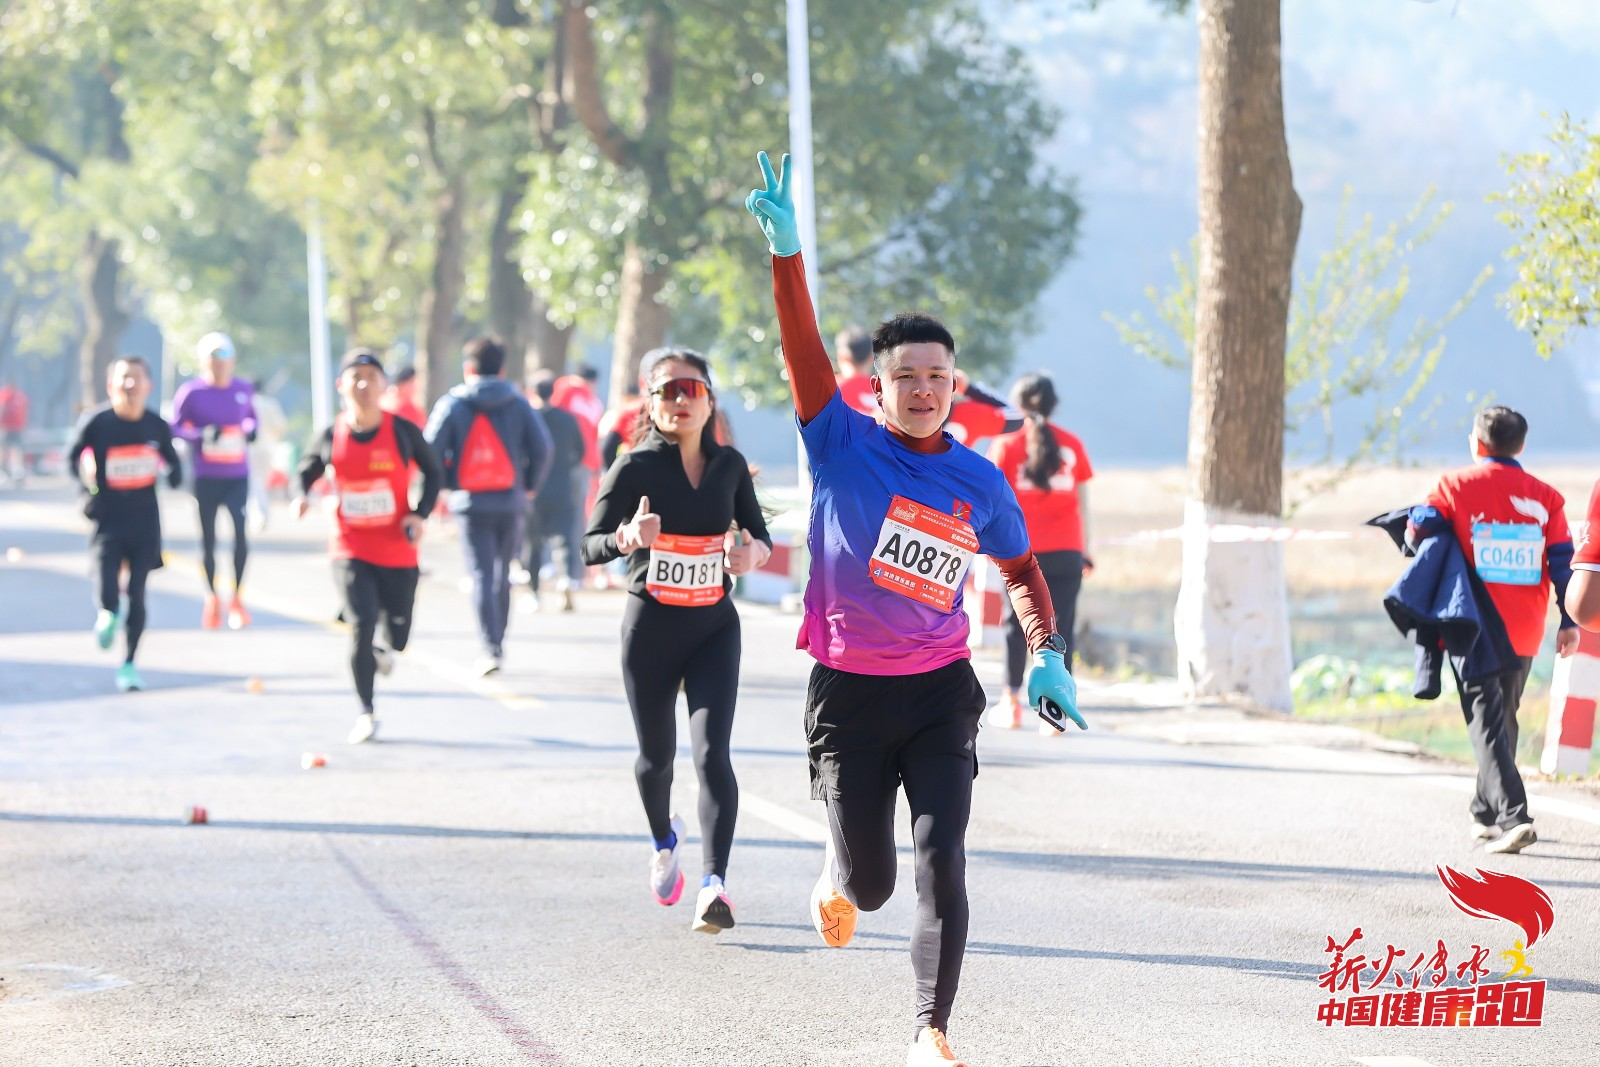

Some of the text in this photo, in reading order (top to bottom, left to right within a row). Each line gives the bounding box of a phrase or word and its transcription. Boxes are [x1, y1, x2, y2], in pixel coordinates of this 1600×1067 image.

[879, 533, 962, 584] A0878
[1480, 547, 1535, 567] C0461
[656, 560, 716, 585] B0181
